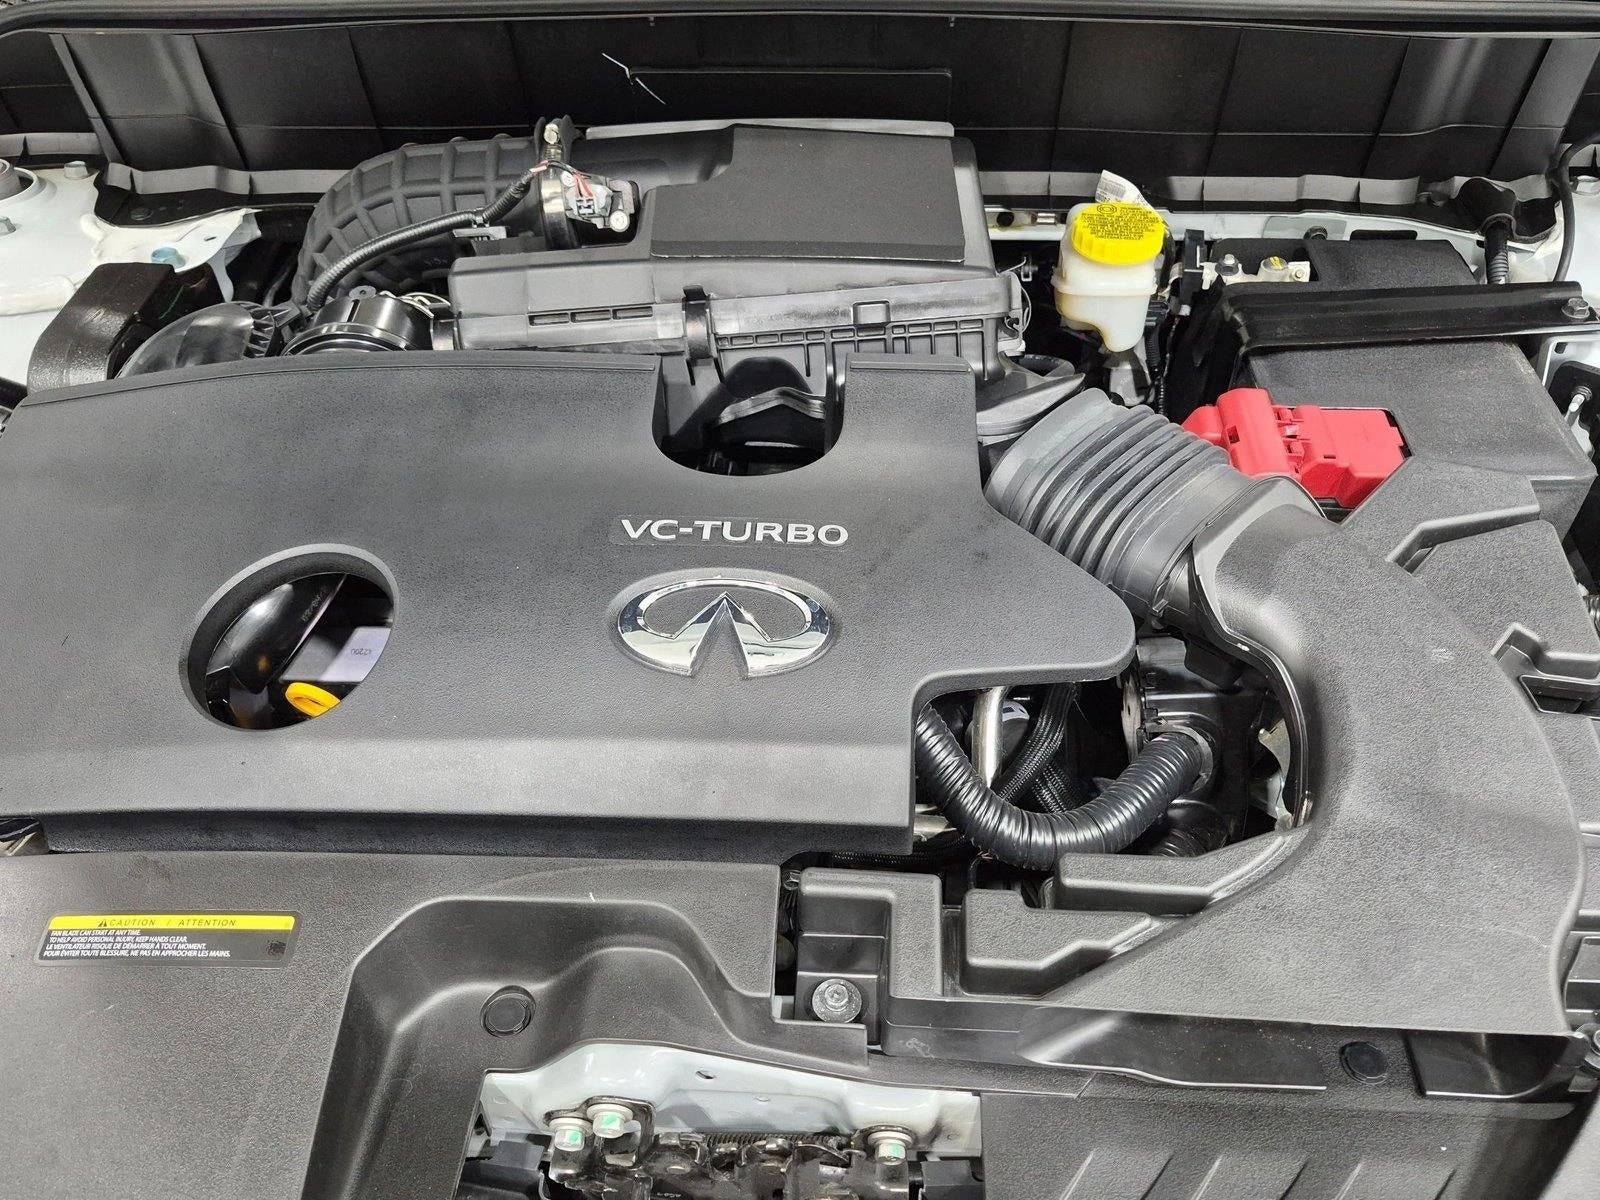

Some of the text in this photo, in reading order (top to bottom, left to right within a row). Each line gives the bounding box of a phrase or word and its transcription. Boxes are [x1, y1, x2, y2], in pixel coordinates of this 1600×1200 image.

[621, 519, 849, 546] VC-TURBO
[109, 919, 156, 927] CAUTION
[178, 919, 237, 927] ATTENTION
